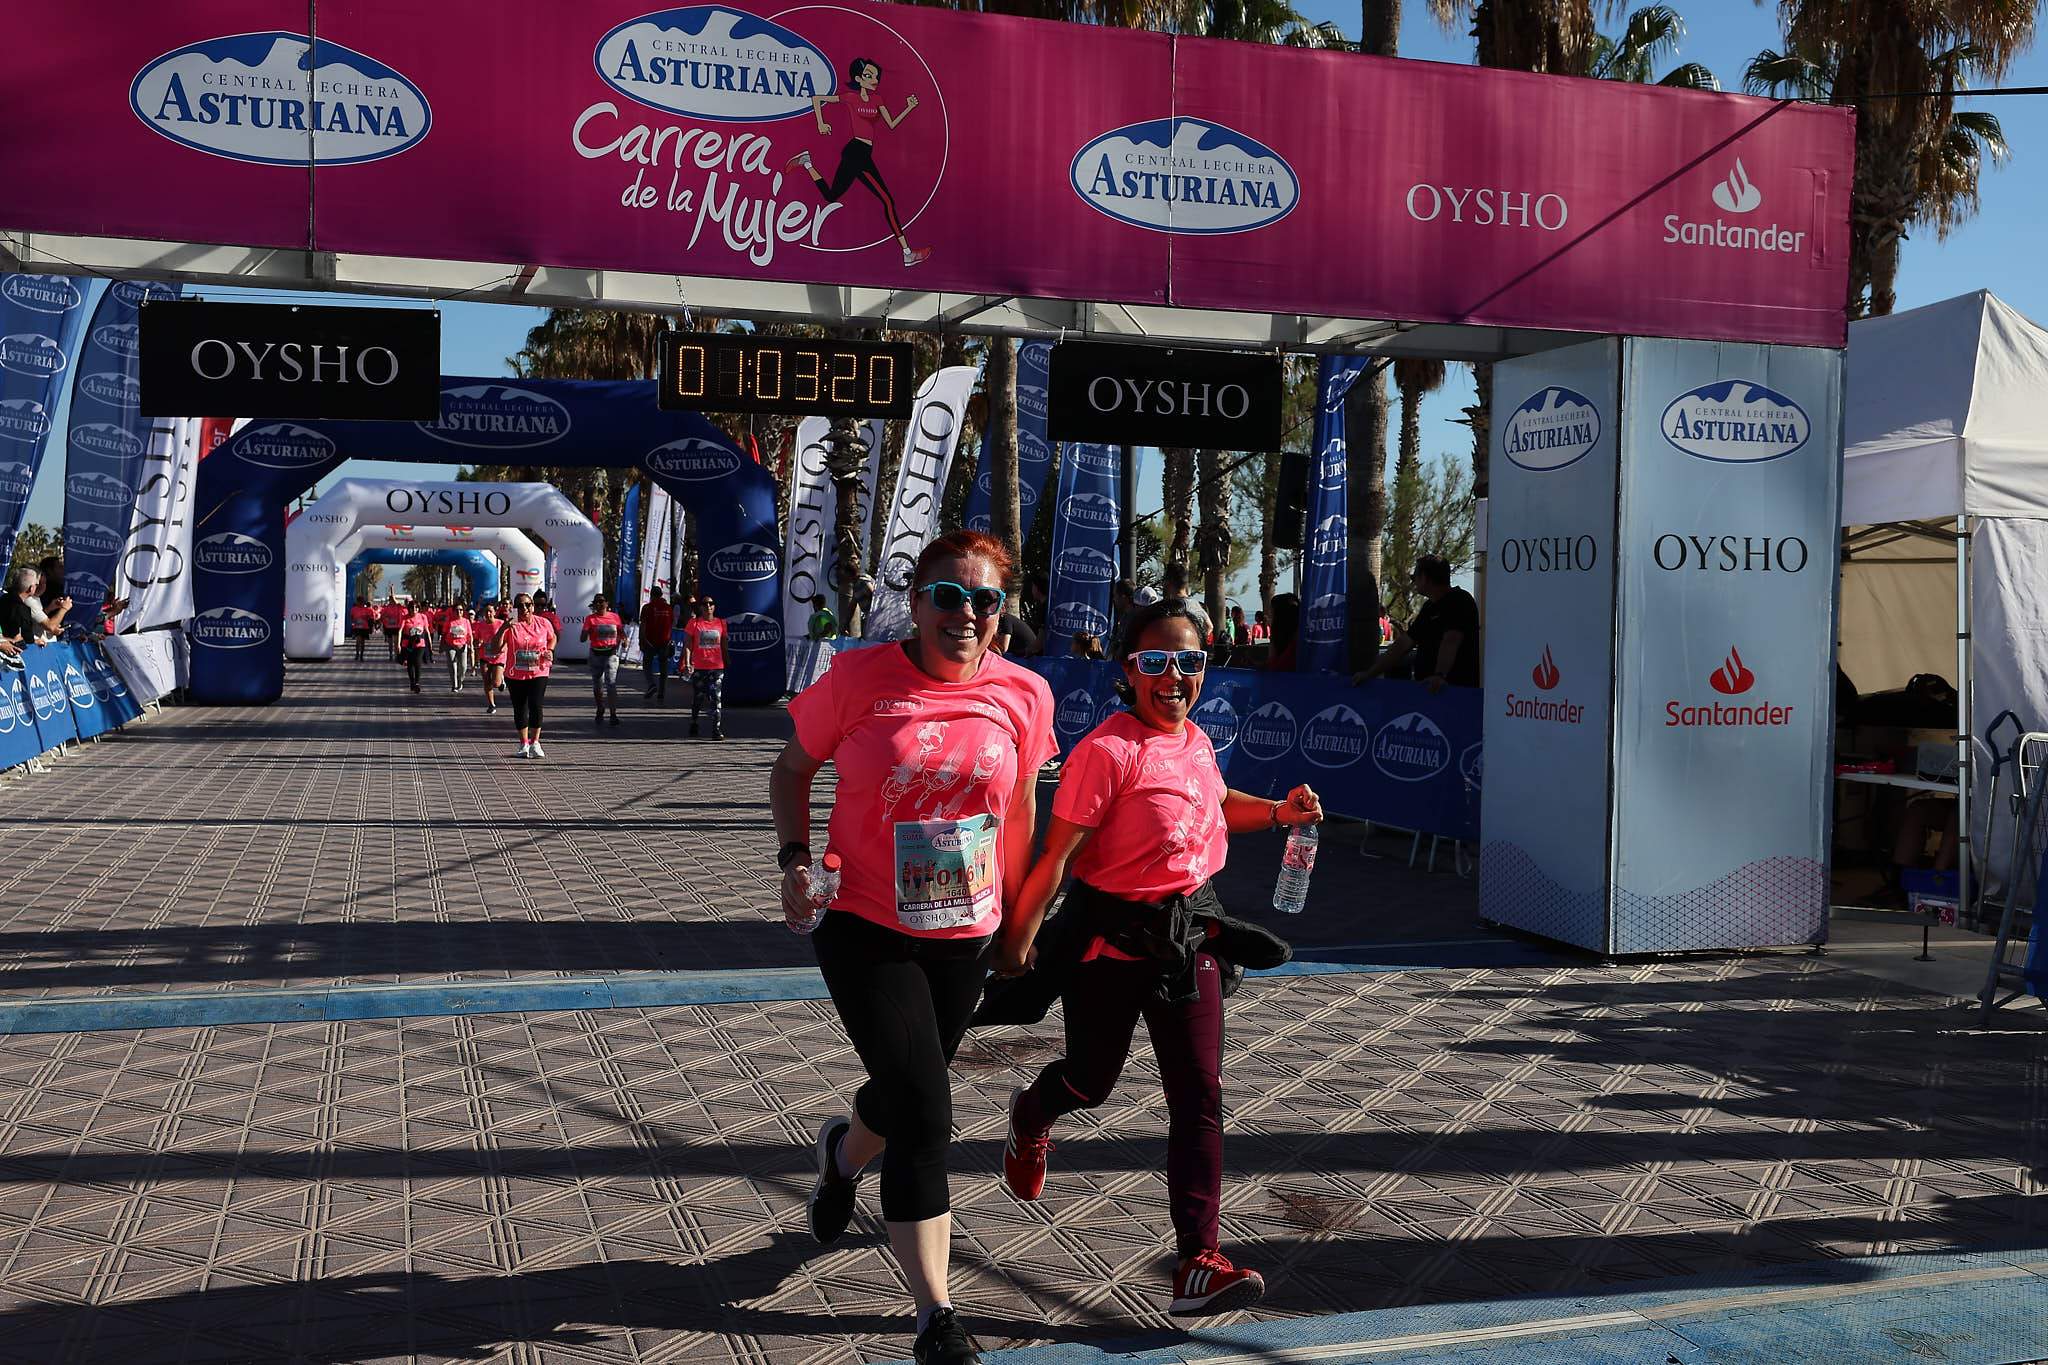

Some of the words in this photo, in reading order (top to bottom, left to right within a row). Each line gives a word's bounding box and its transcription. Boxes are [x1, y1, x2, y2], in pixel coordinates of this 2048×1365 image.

[652, 39, 728, 58] CENTRAL
[736, 47, 811, 65] LECHERA
[202, 72, 296, 91] CENTRAL
[614, 38, 817, 99] ASTURIANA
[154, 72, 409, 137] ASTURIANA
[572, 101, 771, 175] Carrera
[1125, 153, 1196, 169] CENTRAL
[1203, 159, 1275, 175] LECHERA
[1089, 152, 1282, 209] ASTURIANA
[621, 168, 658, 209] de
[666, 170, 693, 213] la
[686, 171, 844, 267] Mujer
[1406, 183, 1568, 231] OYSHO
[1663, 214, 1805, 253] Santander
[191, 339, 399, 386] OYSHO
[1087, 376, 1250, 419] OYSHO
[1523, 416, 1554, 428] CENTRAL
[1556, 410, 1590, 422] LECHERA
[1672, 407, 1800, 445] ASTURIANA
[1695, 407, 1743, 418] CENTRAL
[1746, 408, 1796, 420] LECHERA
[240, 440, 328, 458] ASTURIANA
[1509, 422, 1593, 454] ASTURIANA
[654, 455, 735, 470] ASTURIANA
[386, 489, 511, 516] OYSHO
[884, 400, 955, 592] OYSHO
[309, 514, 349, 524] OYSHO
[545, 518, 582, 527] OYSHO
[198, 547, 267, 565] ASTURIANA
[713, 557, 776, 572] ASTURIANA
[1501, 534, 1598, 574] OYSHO
[1653, 534, 1808, 573] OYSHO
[291, 563, 329, 573] OYSHO
[563, 568, 598, 577] OYSHO
[196, 621, 265, 639] ASTURIANA
[290, 614, 327, 623] OYSHO
[1505, 693, 1584, 725] Santander
[1665, 701, 1793, 727] Santander
[1242, 721, 1292, 747] ASTURIANA
[1304, 725, 1362, 755] ASTURIANA
[1376, 735, 1440, 769] ASTURIANA
[904, 903, 933, 911] CARRERA
[910, 912, 947, 924] OYSHO
